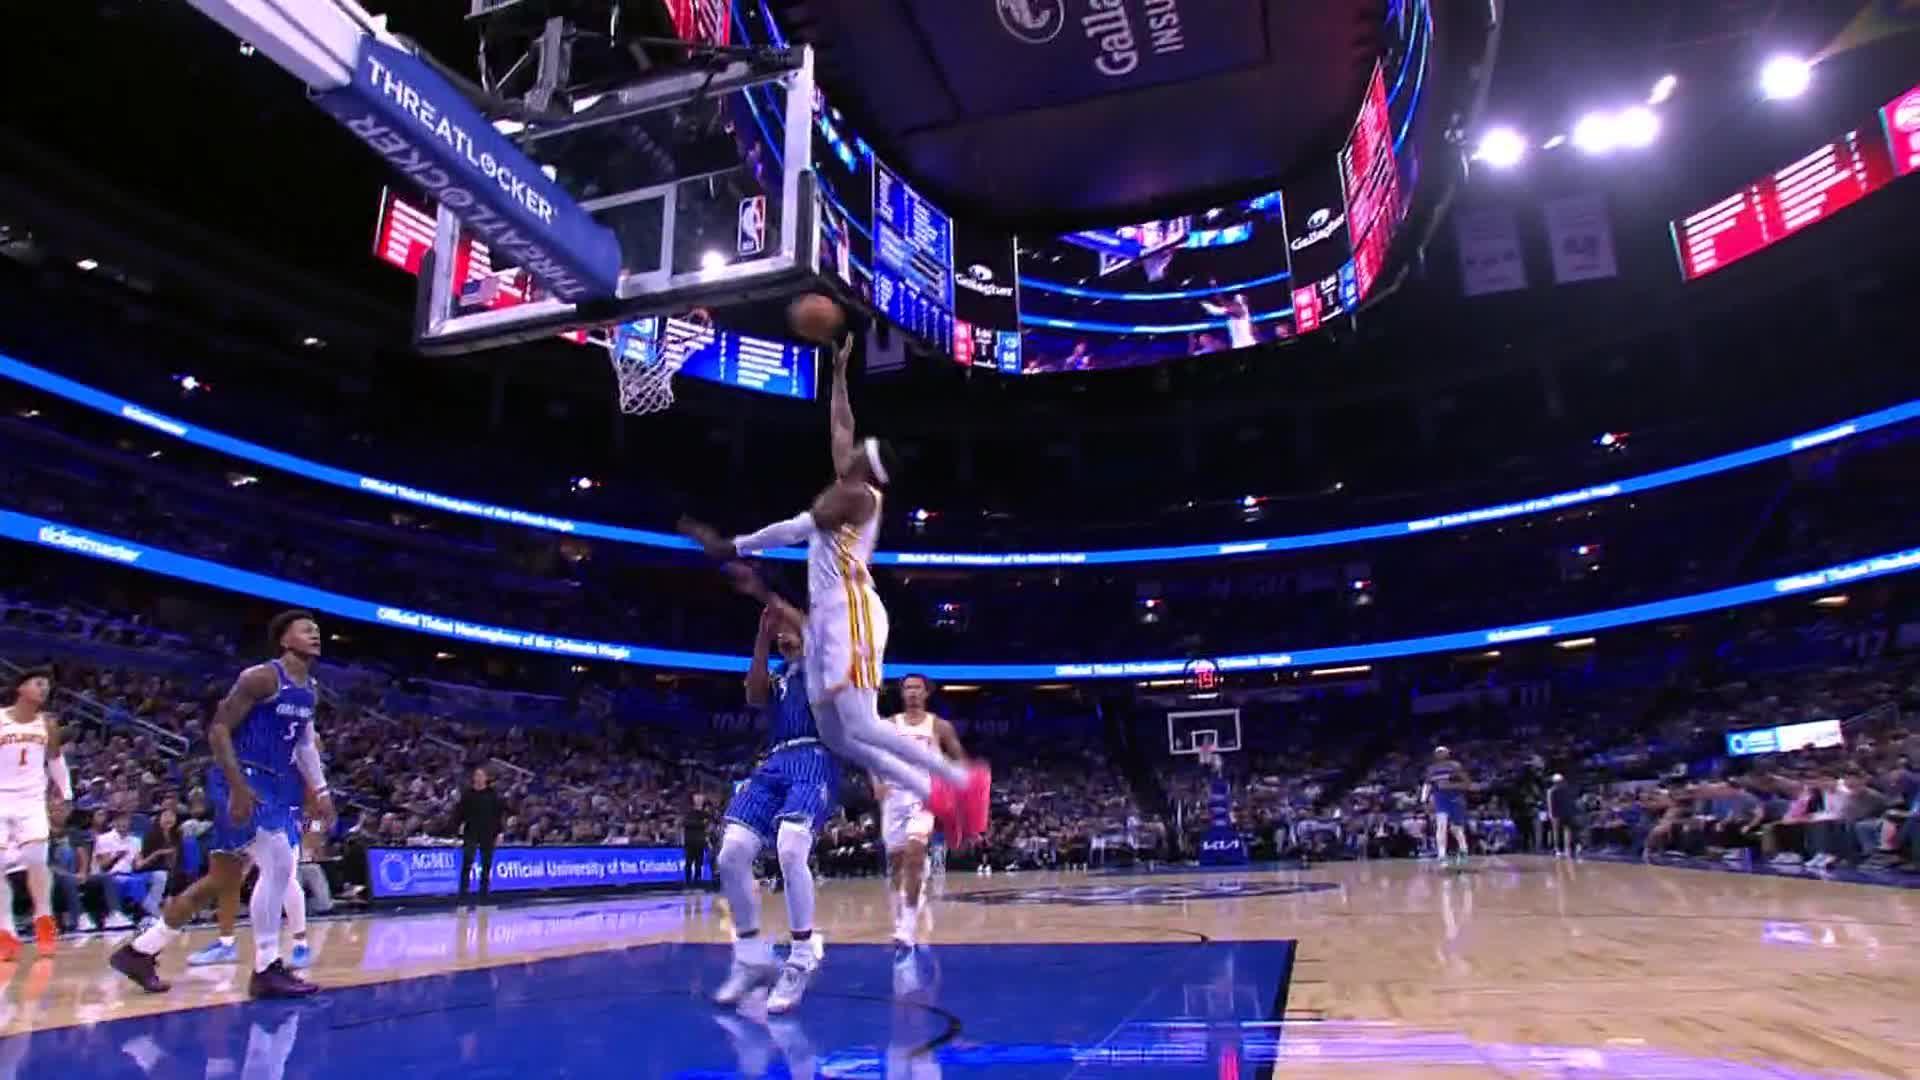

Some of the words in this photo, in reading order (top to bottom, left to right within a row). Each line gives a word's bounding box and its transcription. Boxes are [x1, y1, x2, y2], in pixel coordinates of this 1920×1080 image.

[367, 55, 553, 226] THREATLOCKER
[19, 748, 27, 766] 1
[496, 860, 546, 879] Official
[547, 860, 605, 879] University
[607, 856, 618, 875] of
[620, 859, 639, 875] the
[640, 858, 679, 874] Orlando
